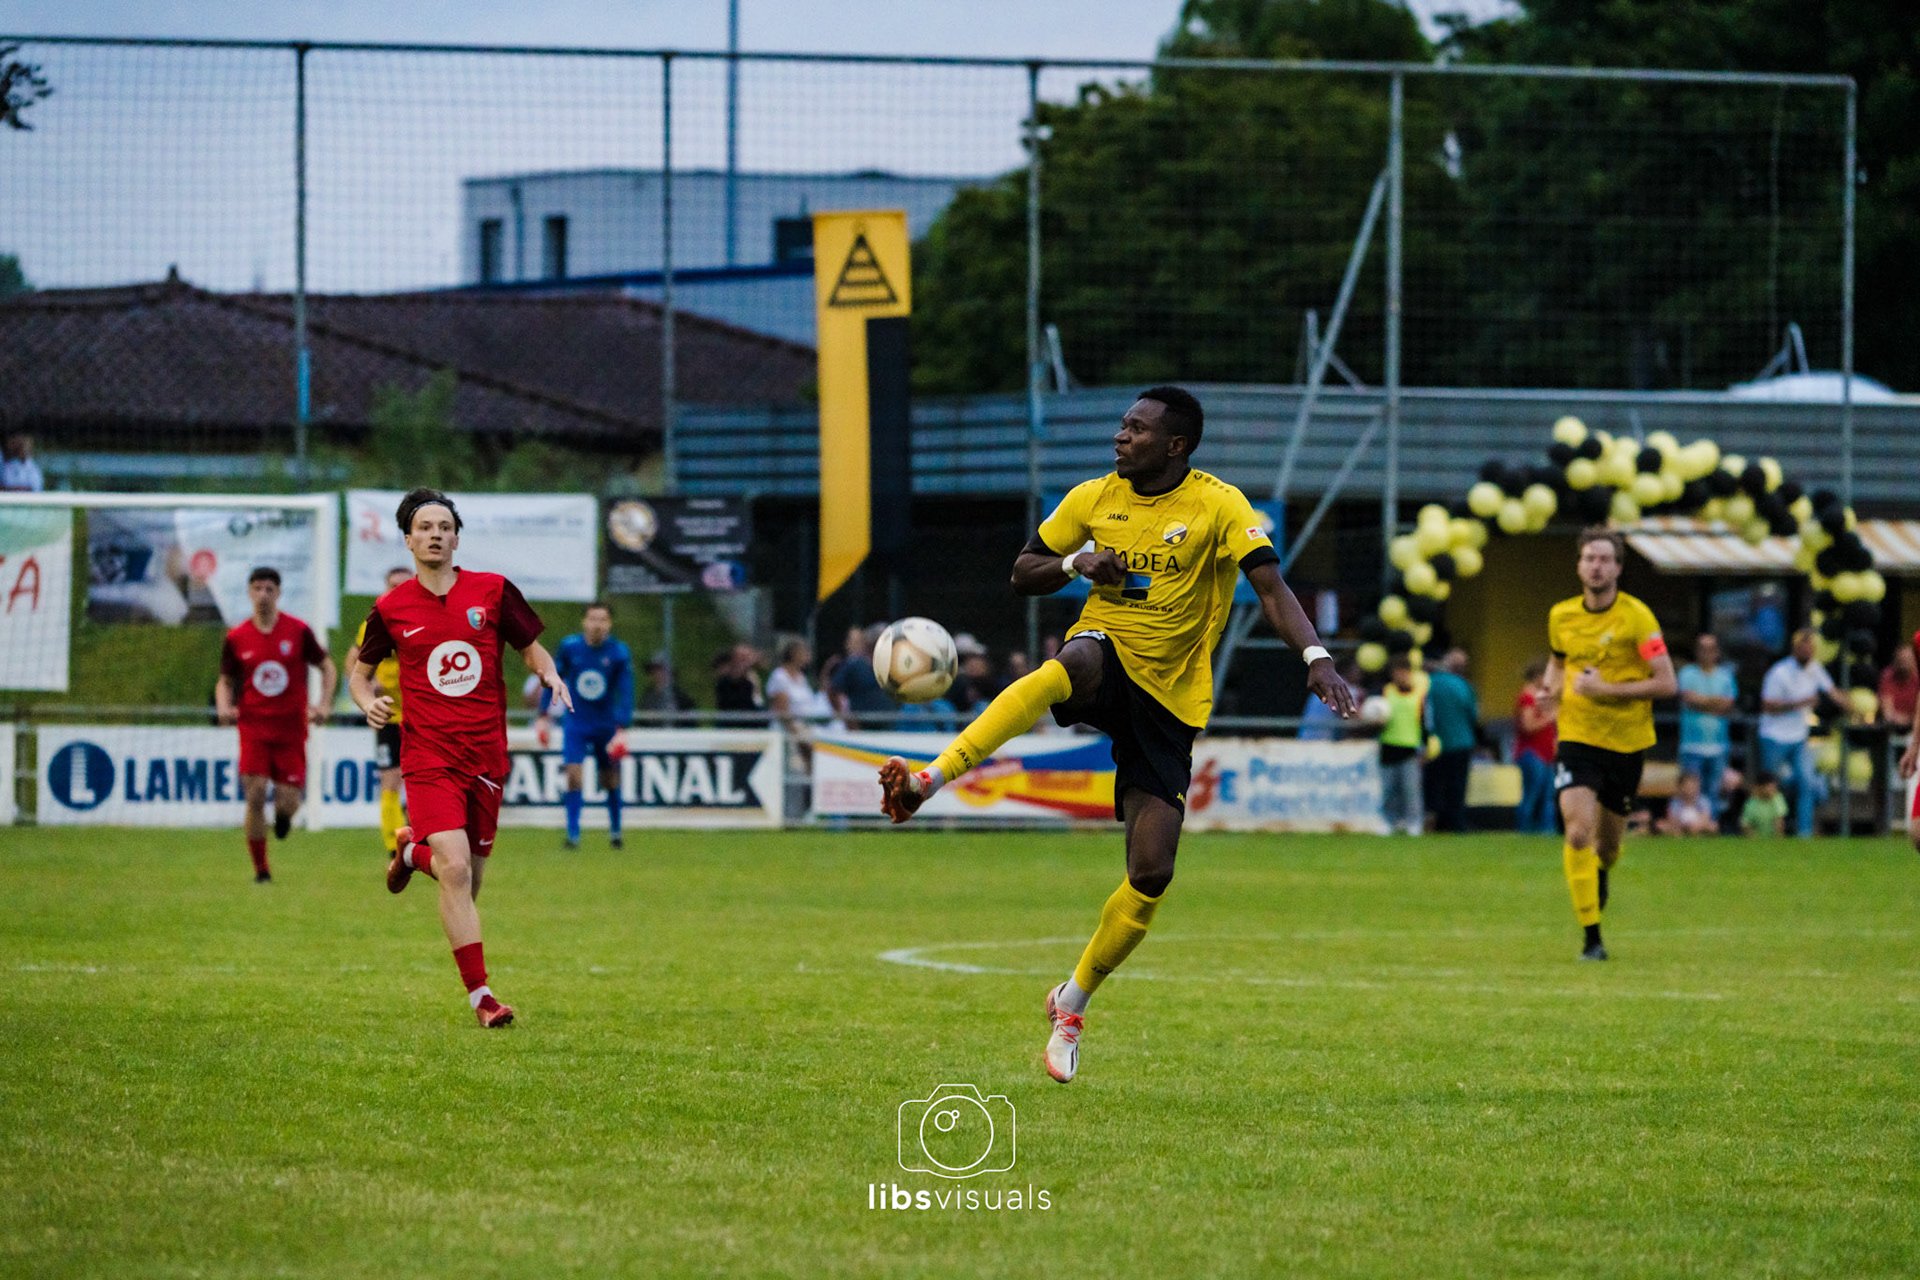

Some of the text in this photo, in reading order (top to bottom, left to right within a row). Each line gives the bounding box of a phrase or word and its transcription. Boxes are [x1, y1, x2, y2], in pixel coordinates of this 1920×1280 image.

[1107, 513, 1129, 521] JAKO
[0, 554, 40, 614] A
[439, 674, 476, 687] Saudan
[955, 747, 973, 769] JAKO
